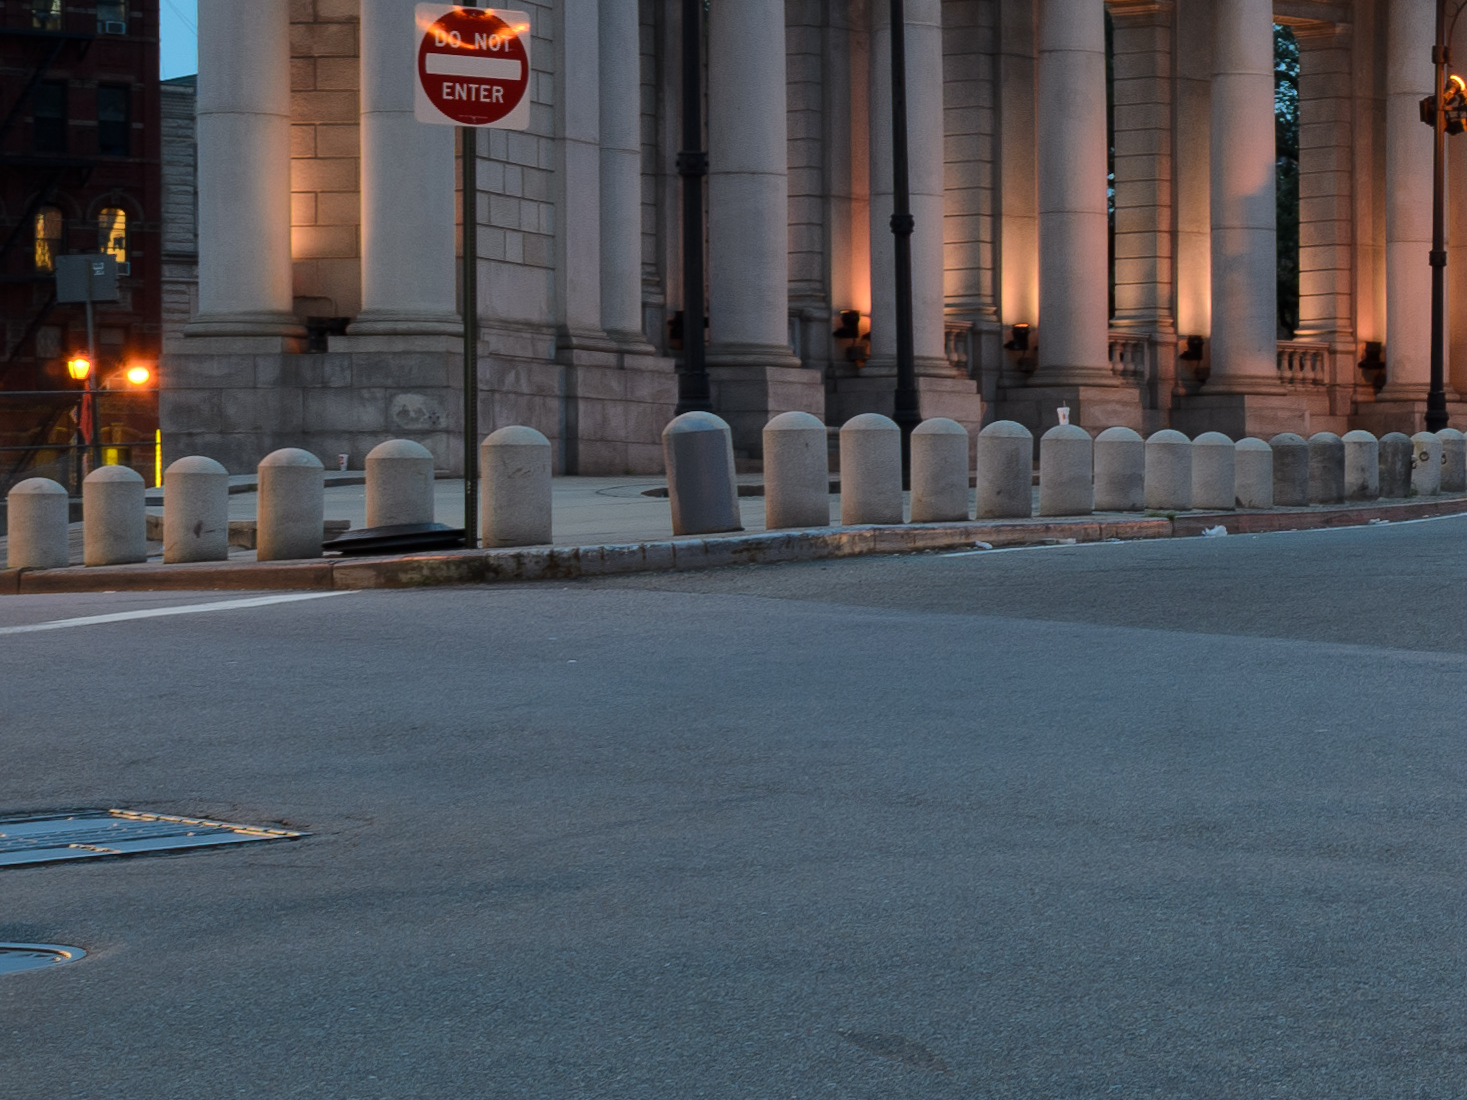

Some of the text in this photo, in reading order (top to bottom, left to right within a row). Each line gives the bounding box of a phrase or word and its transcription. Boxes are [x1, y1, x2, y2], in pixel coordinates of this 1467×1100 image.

[435, 30, 510, 52] DO NOT
[442, 81, 504, 104] ENTER
